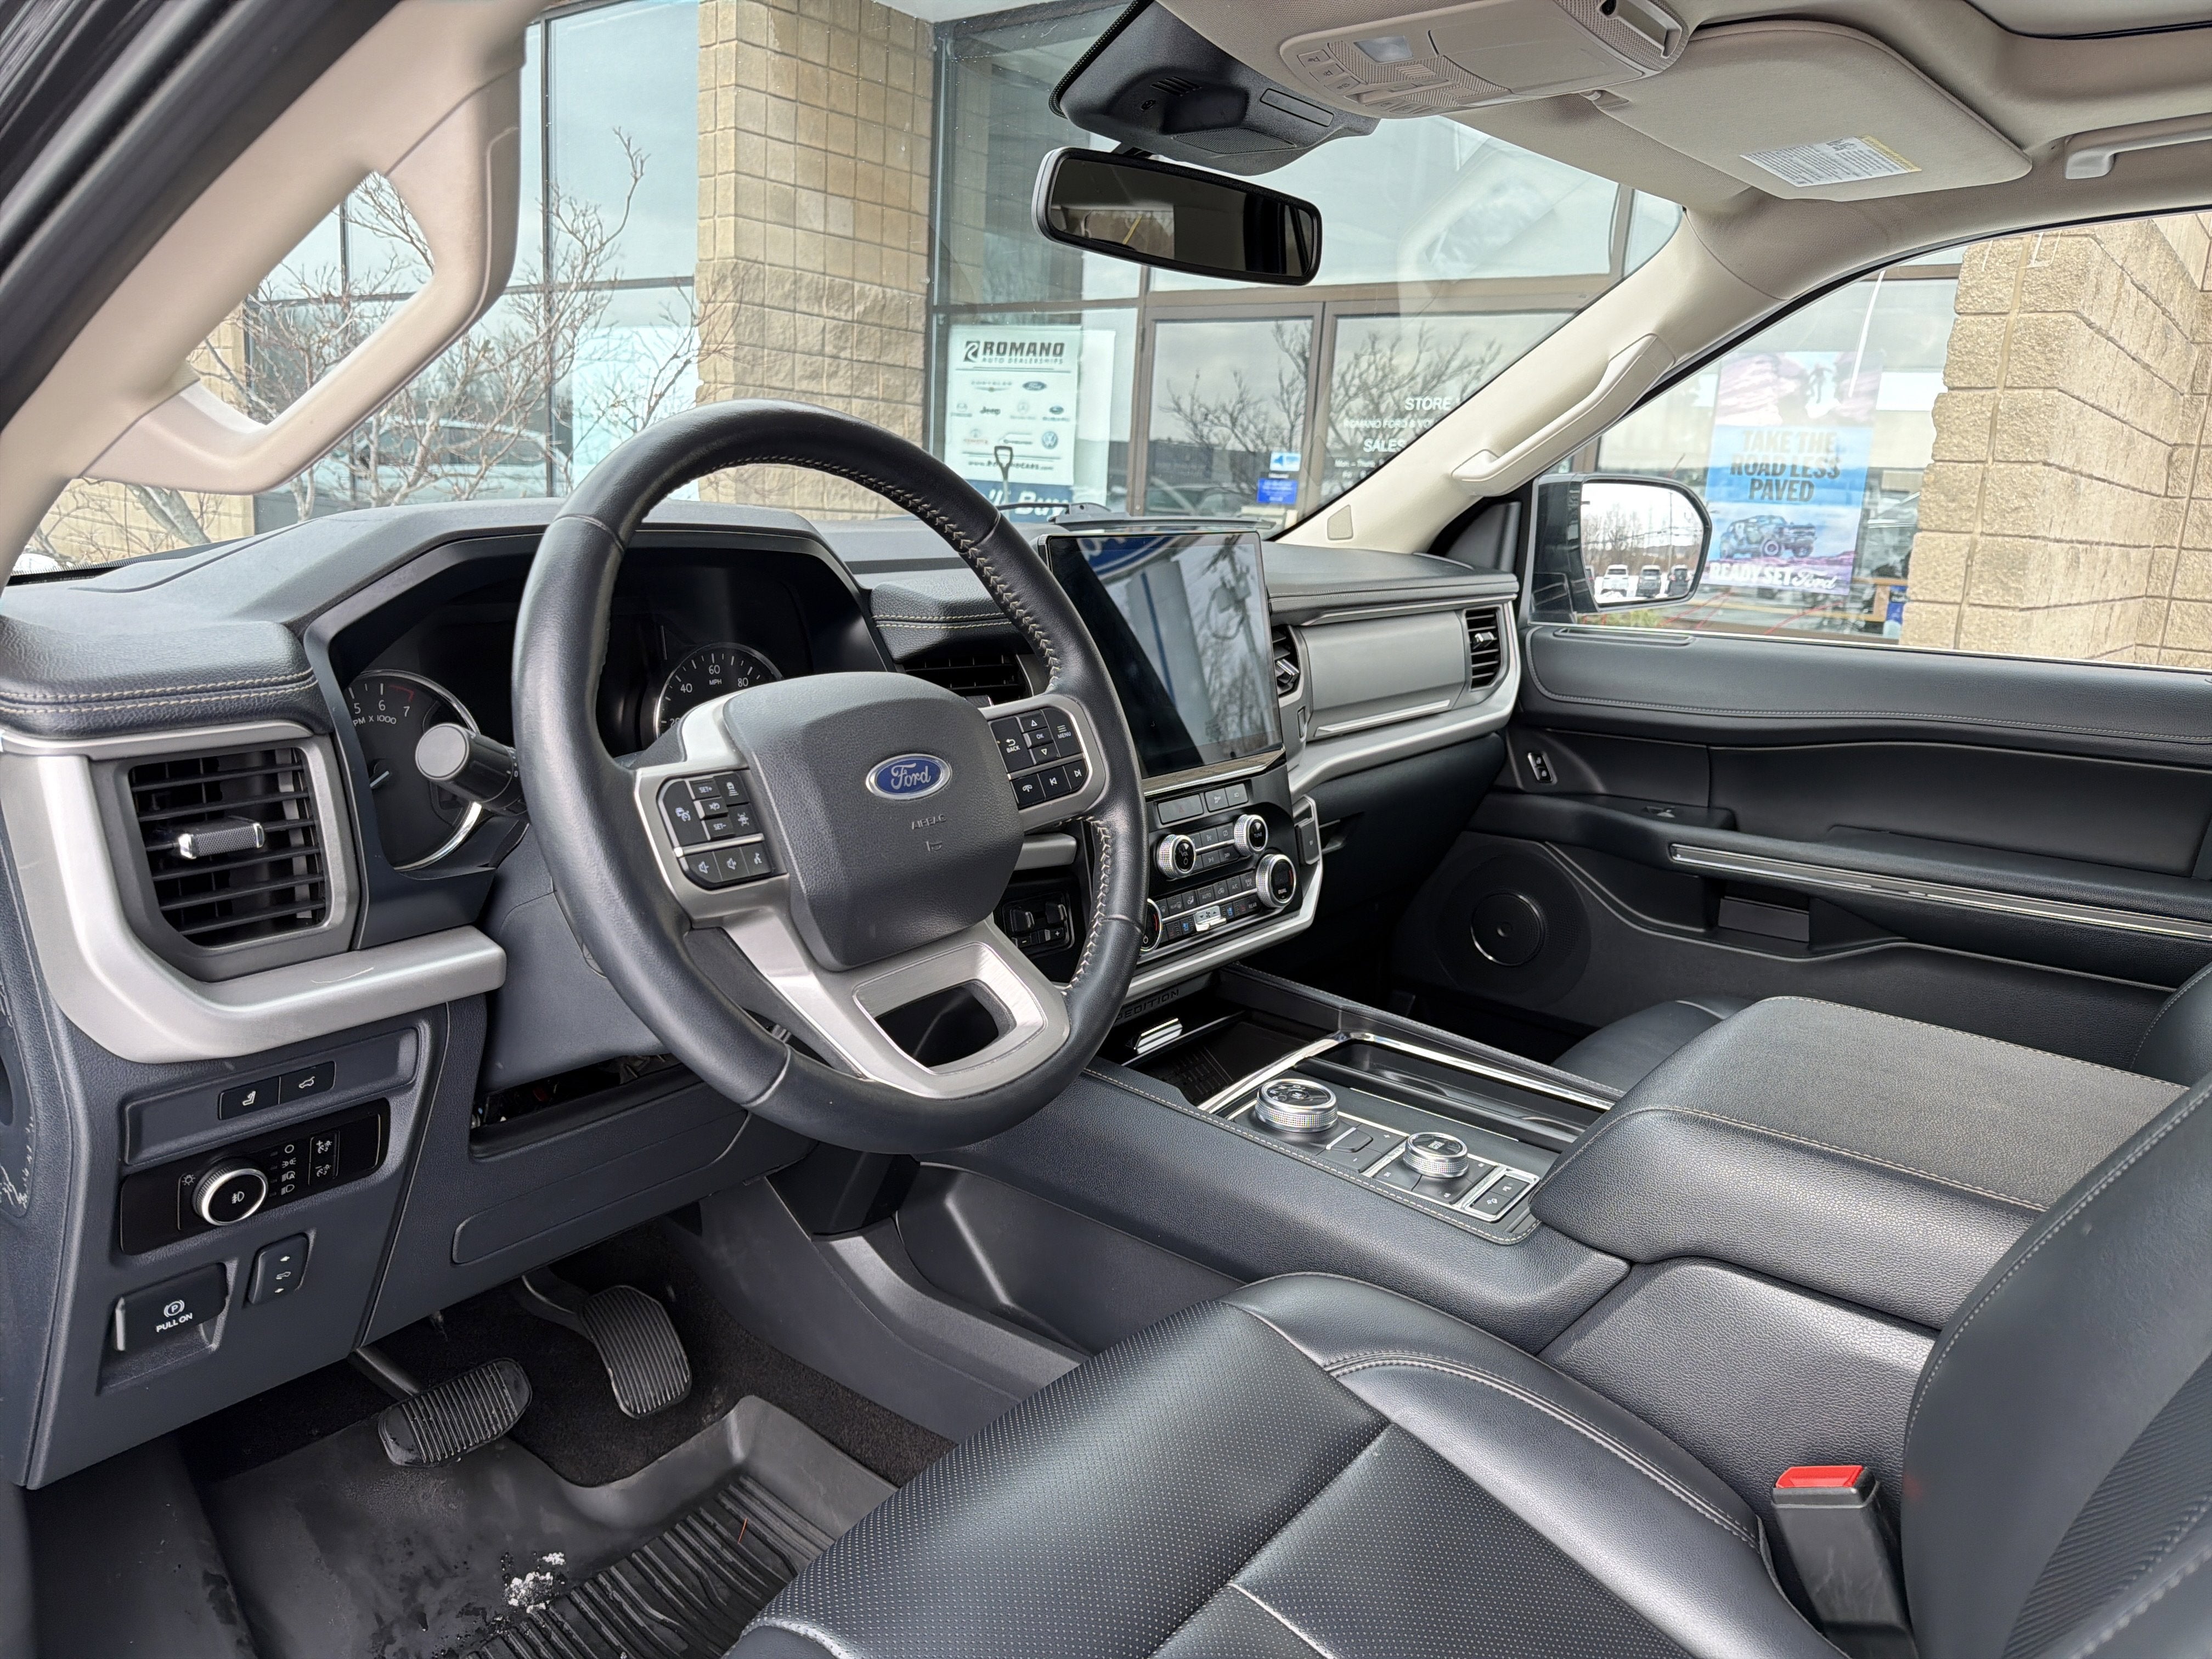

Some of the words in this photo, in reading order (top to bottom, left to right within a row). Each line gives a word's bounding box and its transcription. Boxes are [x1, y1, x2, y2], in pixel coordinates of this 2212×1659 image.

[983, 341, 1065, 357] ROMANO
[1404, 397, 1452, 411] STORE
[1363, 439, 1406, 452] SALES
[1742, 430, 1793, 453] TAKE
[1796, 431, 1837, 453] THE
[1730, 453, 1787, 476] ROAD
[1790, 455, 1841, 479] LESS
[1748, 478, 1815, 501] PAVED
[1710, 562, 1762, 583] READY
[1763, 566, 1793, 586] SET
[1792, 569, 1838, 589] Ford
[708, 665, 720, 675] 60
[680, 683, 692, 693] 40
[737, 678, 748, 687] 80
[354, 702, 361, 714] 5
[379, 699, 386, 711] 6
[403, 706, 410, 718] 7
[352, 716, 366, 727] PM
[377, 714, 397, 725] 1000
[890, 763, 932, 790] Ford
[156, 1319, 178, 1333] PULL
[179, 1312, 193, 1323] ON
